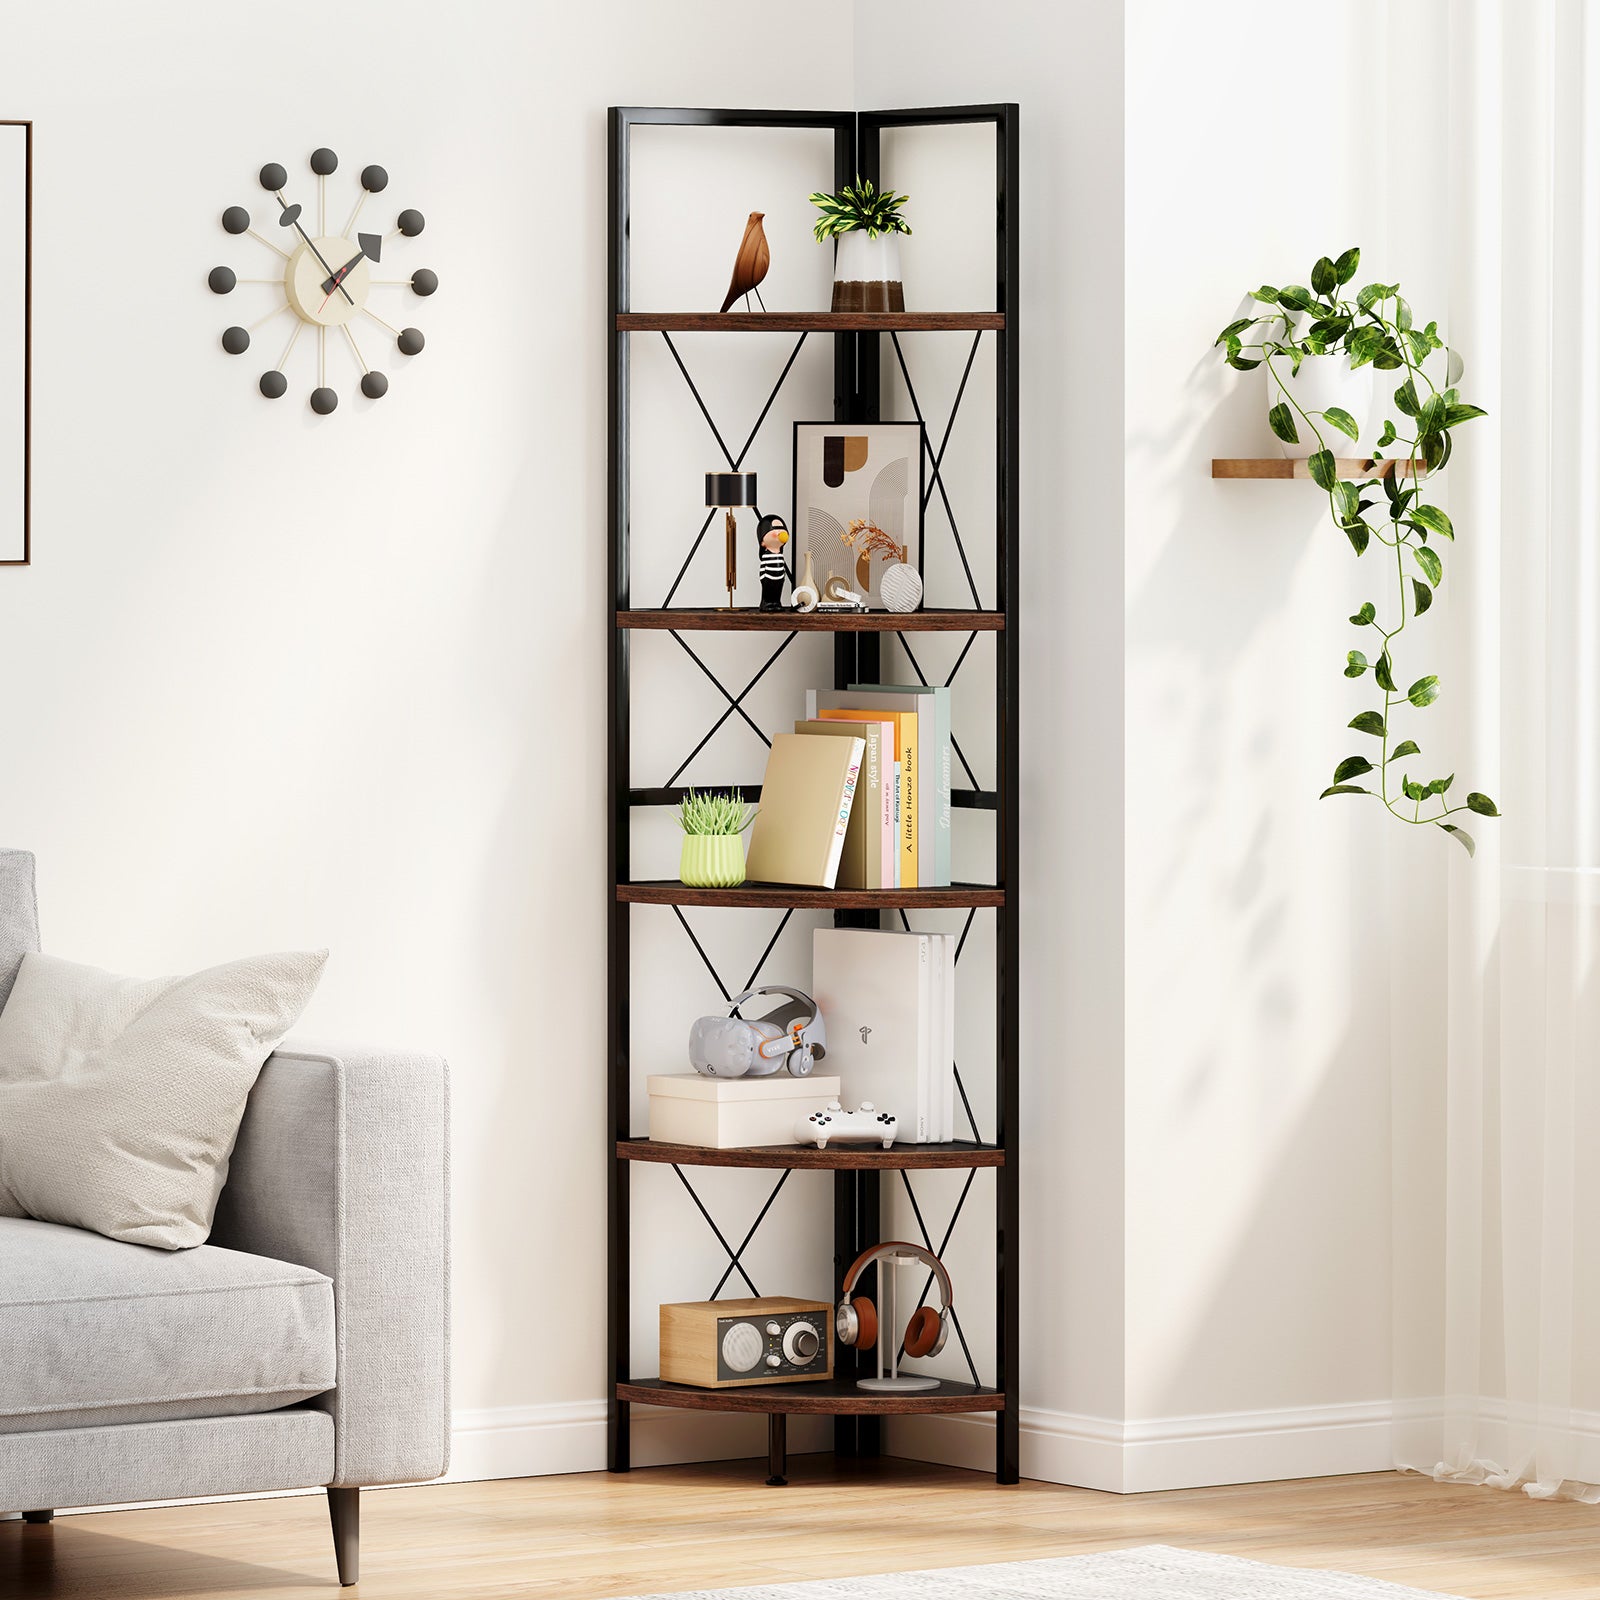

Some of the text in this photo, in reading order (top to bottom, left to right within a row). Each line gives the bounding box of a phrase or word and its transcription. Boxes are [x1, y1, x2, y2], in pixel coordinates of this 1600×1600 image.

[868, 734, 879, 789] Japan style
[905, 747, 913, 853] A little Honzo book
[937, 744, 950, 829] Day dreamers
